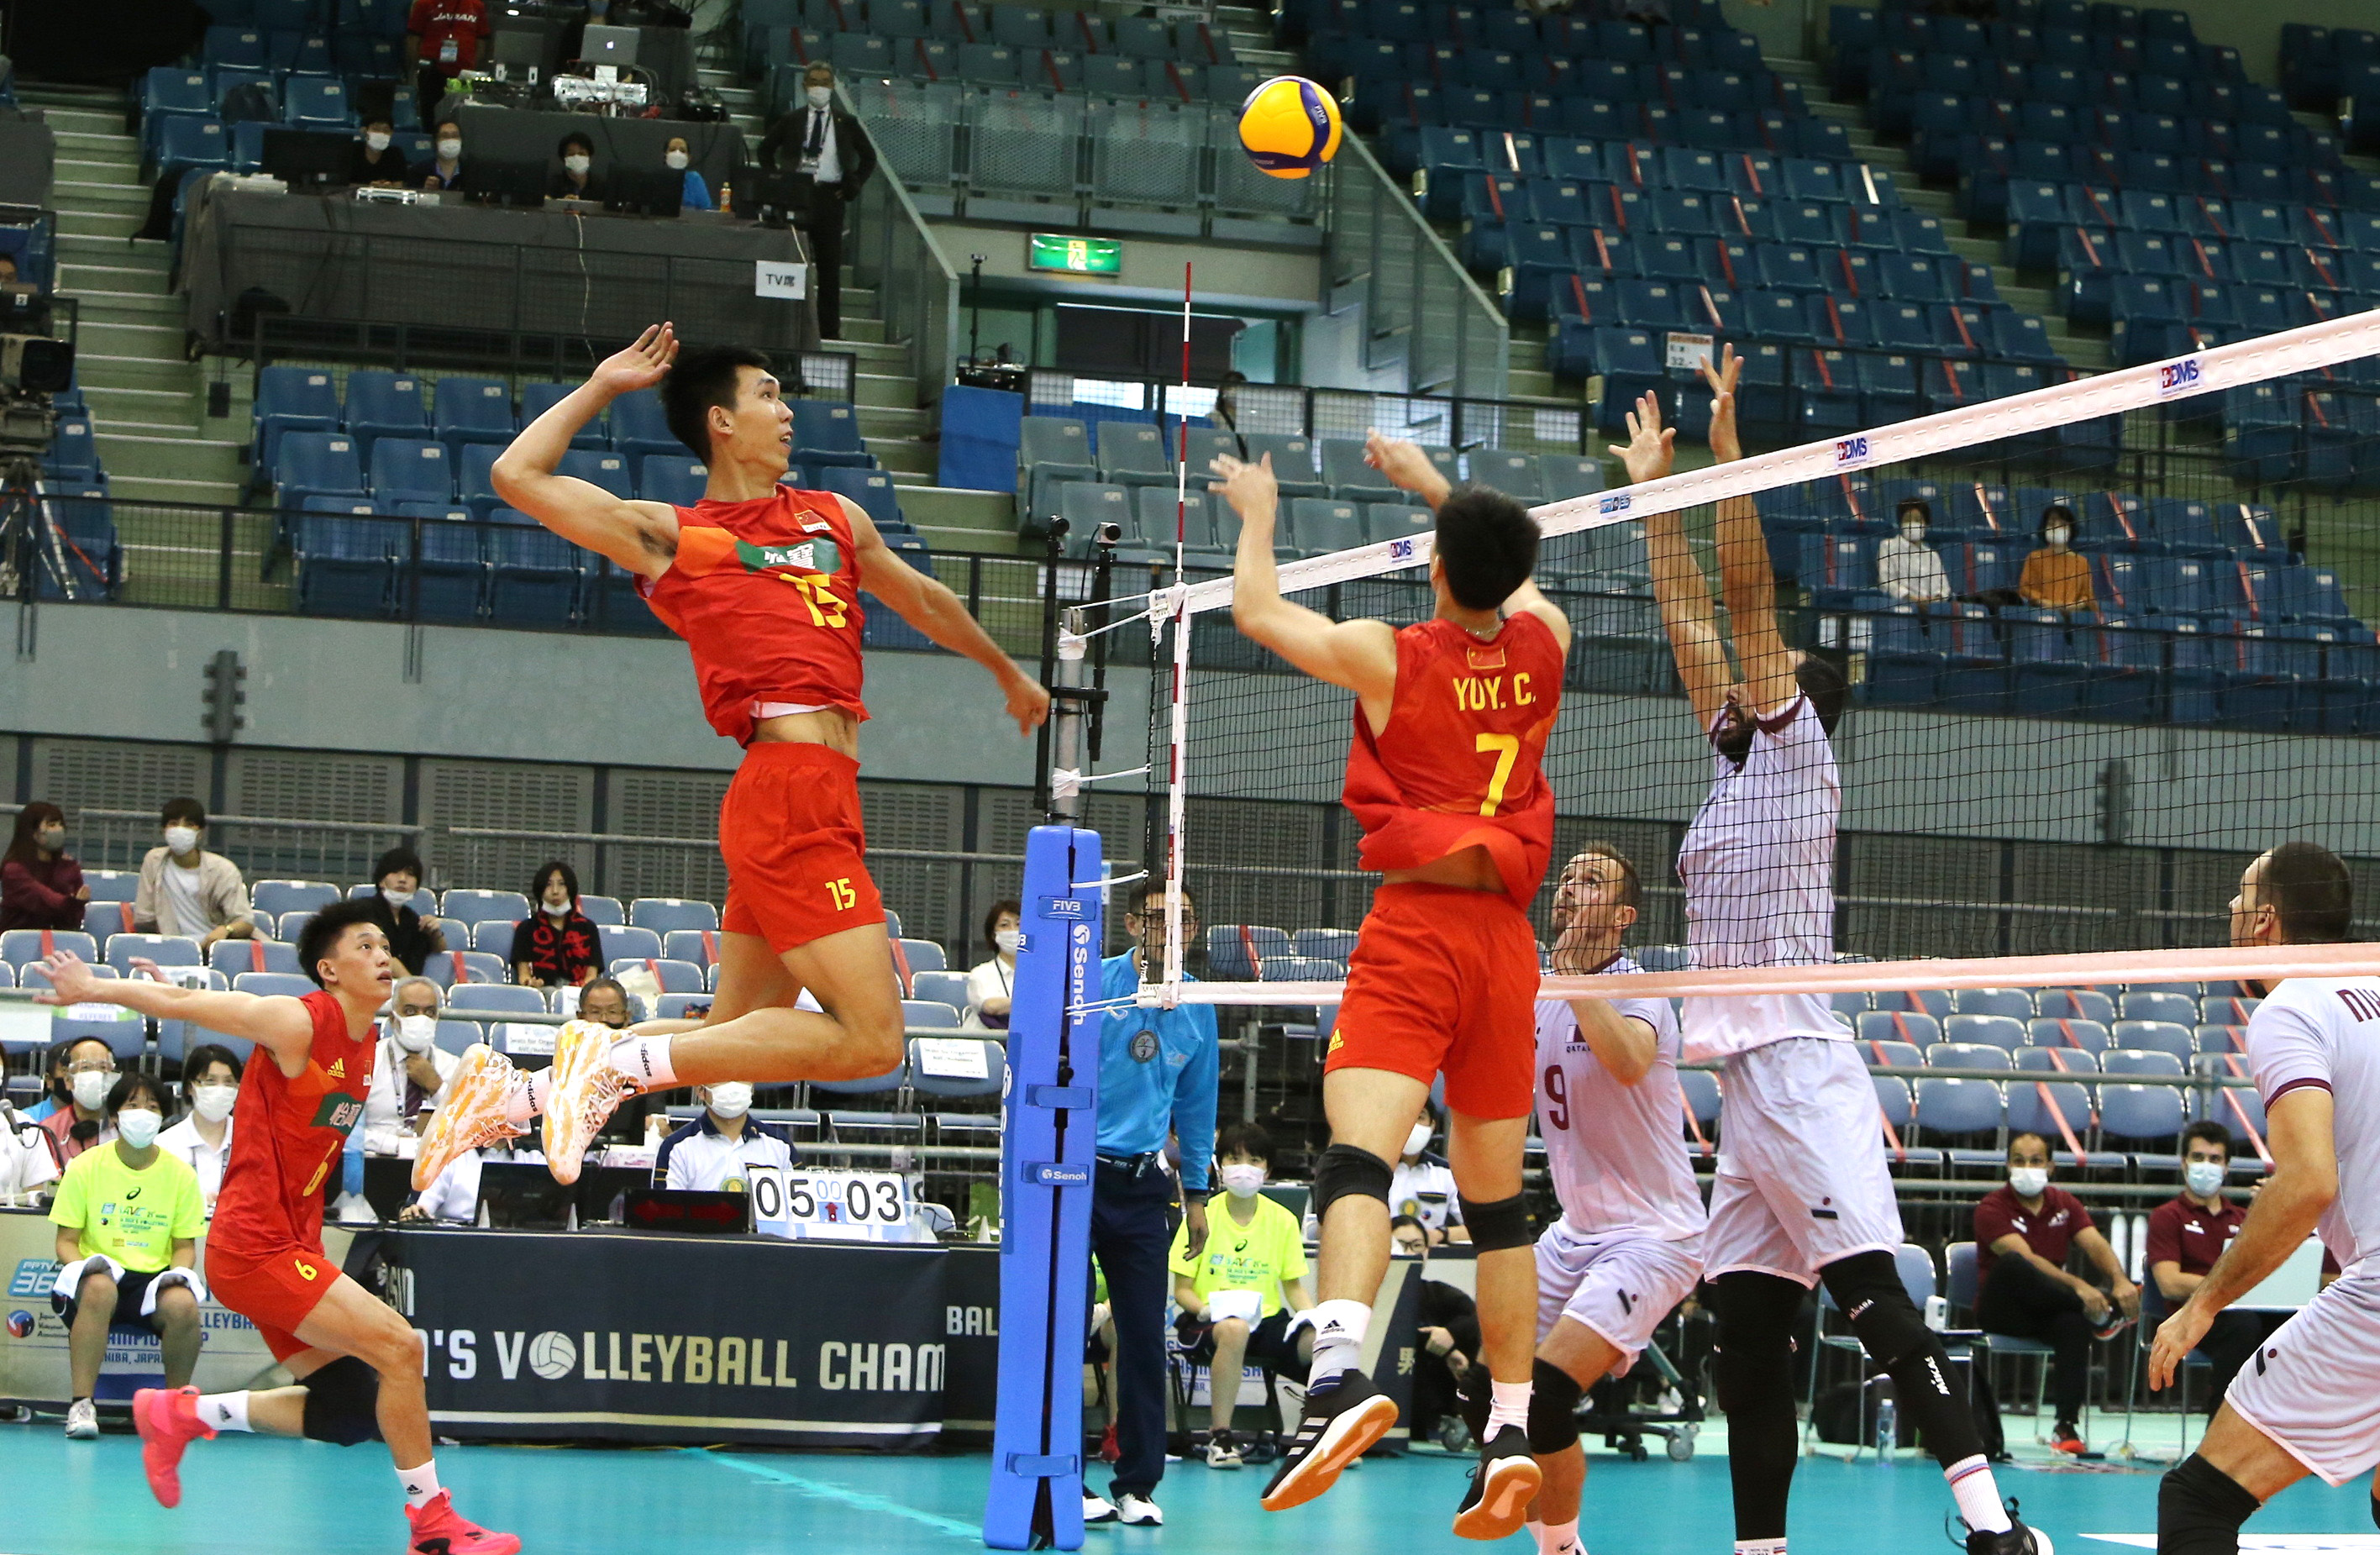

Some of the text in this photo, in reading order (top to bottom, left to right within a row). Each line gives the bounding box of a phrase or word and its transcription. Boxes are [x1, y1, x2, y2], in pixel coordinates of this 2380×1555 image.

[778, 572, 848, 628] 15
[1452, 671, 1537, 712] YUY. C.
[1475, 732, 1521, 818] 7
[824, 877, 856, 911] 15
[1052, 899, 1081, 911] FIVB
[1073, 946, 1088, 1026] Senoh
[1544, 1064, 1570, 1131] 9
[302, 1139, 339, 1197] 6
[1053, 1170, 1087, 1181] Senoh
[847, 1180, 902, 1222] 03
[294, 1258, 318, 1281] 6
